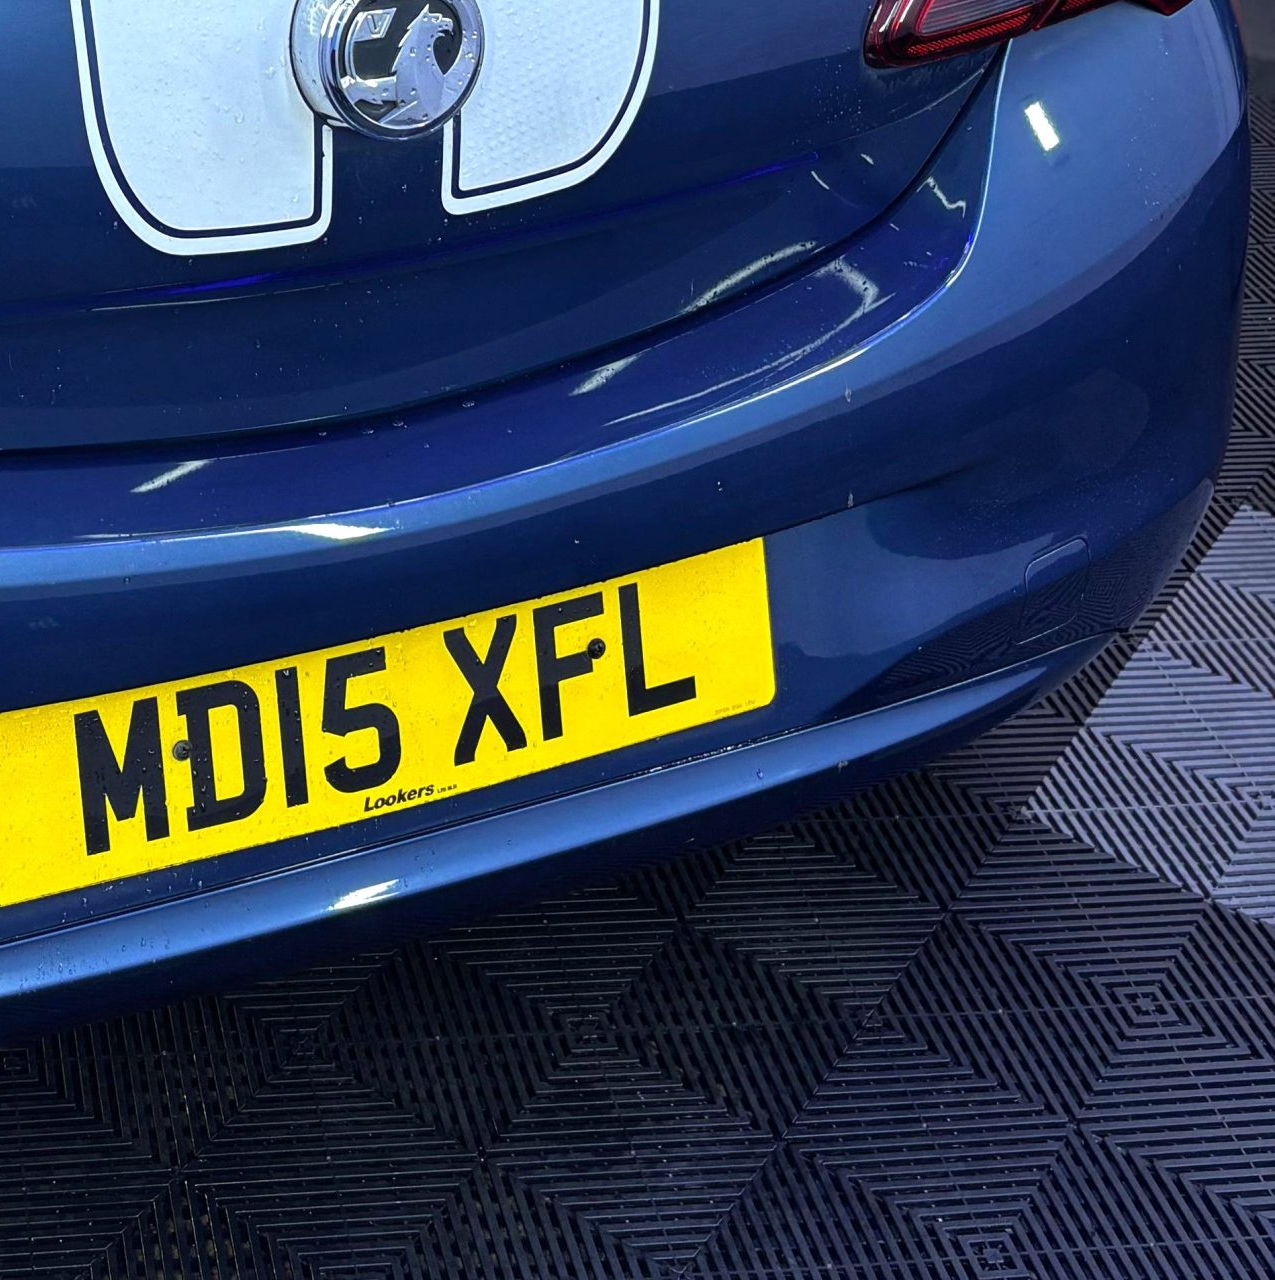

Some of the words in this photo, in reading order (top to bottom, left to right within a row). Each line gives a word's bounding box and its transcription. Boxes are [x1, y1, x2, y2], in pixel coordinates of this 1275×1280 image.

[74, 646, 402, 857] MD15
[443, 582, 698, 768] XFL
[364, 784, 435, 812] Lookers
